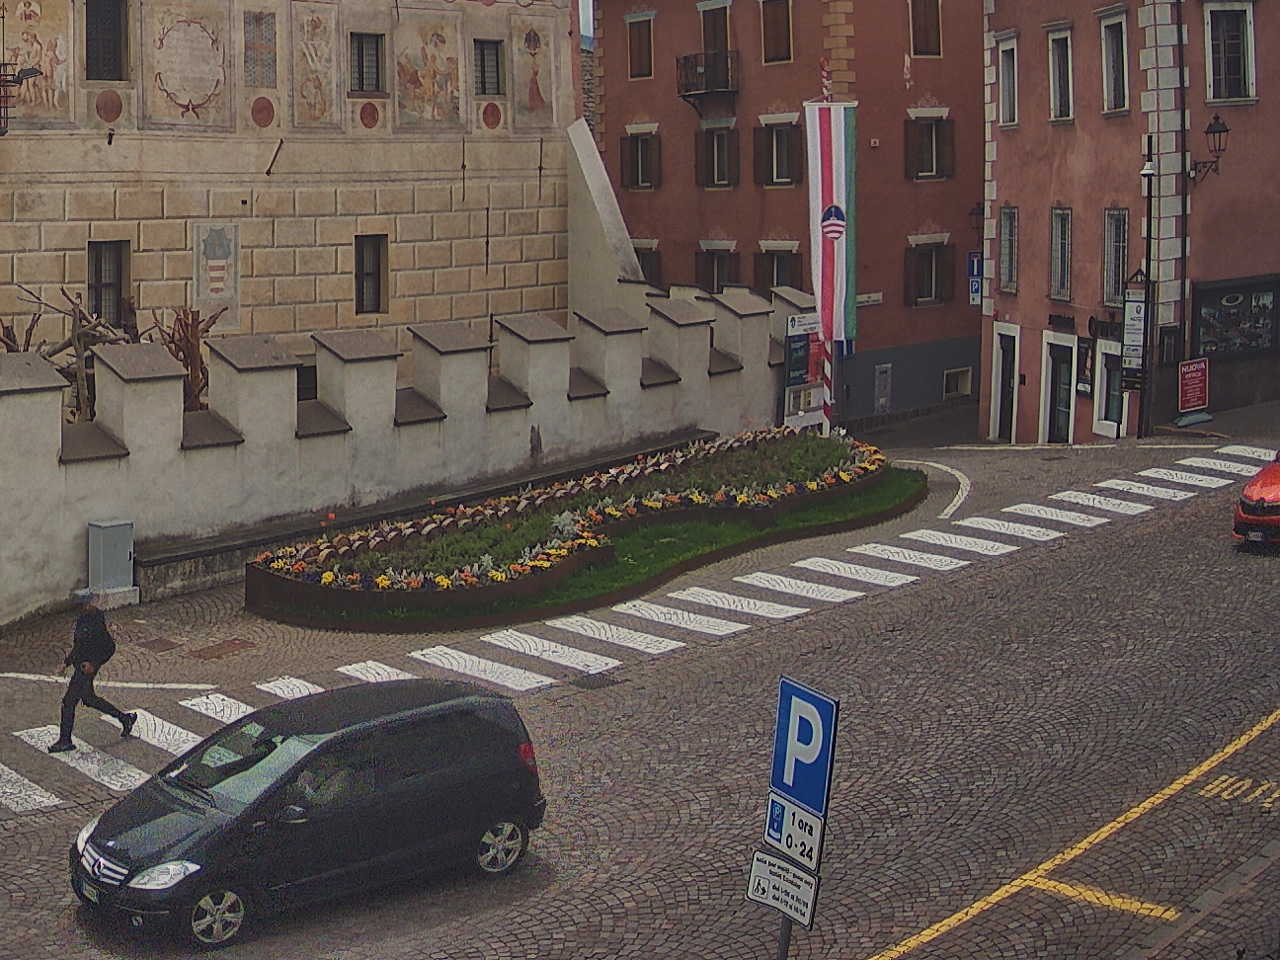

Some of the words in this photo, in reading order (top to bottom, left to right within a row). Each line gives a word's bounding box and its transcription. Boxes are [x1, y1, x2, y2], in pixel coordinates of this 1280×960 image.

[783, 695, 823, 787] P
[791, 811, 796, 826] 1
[798, 818, 814, 837] ora
